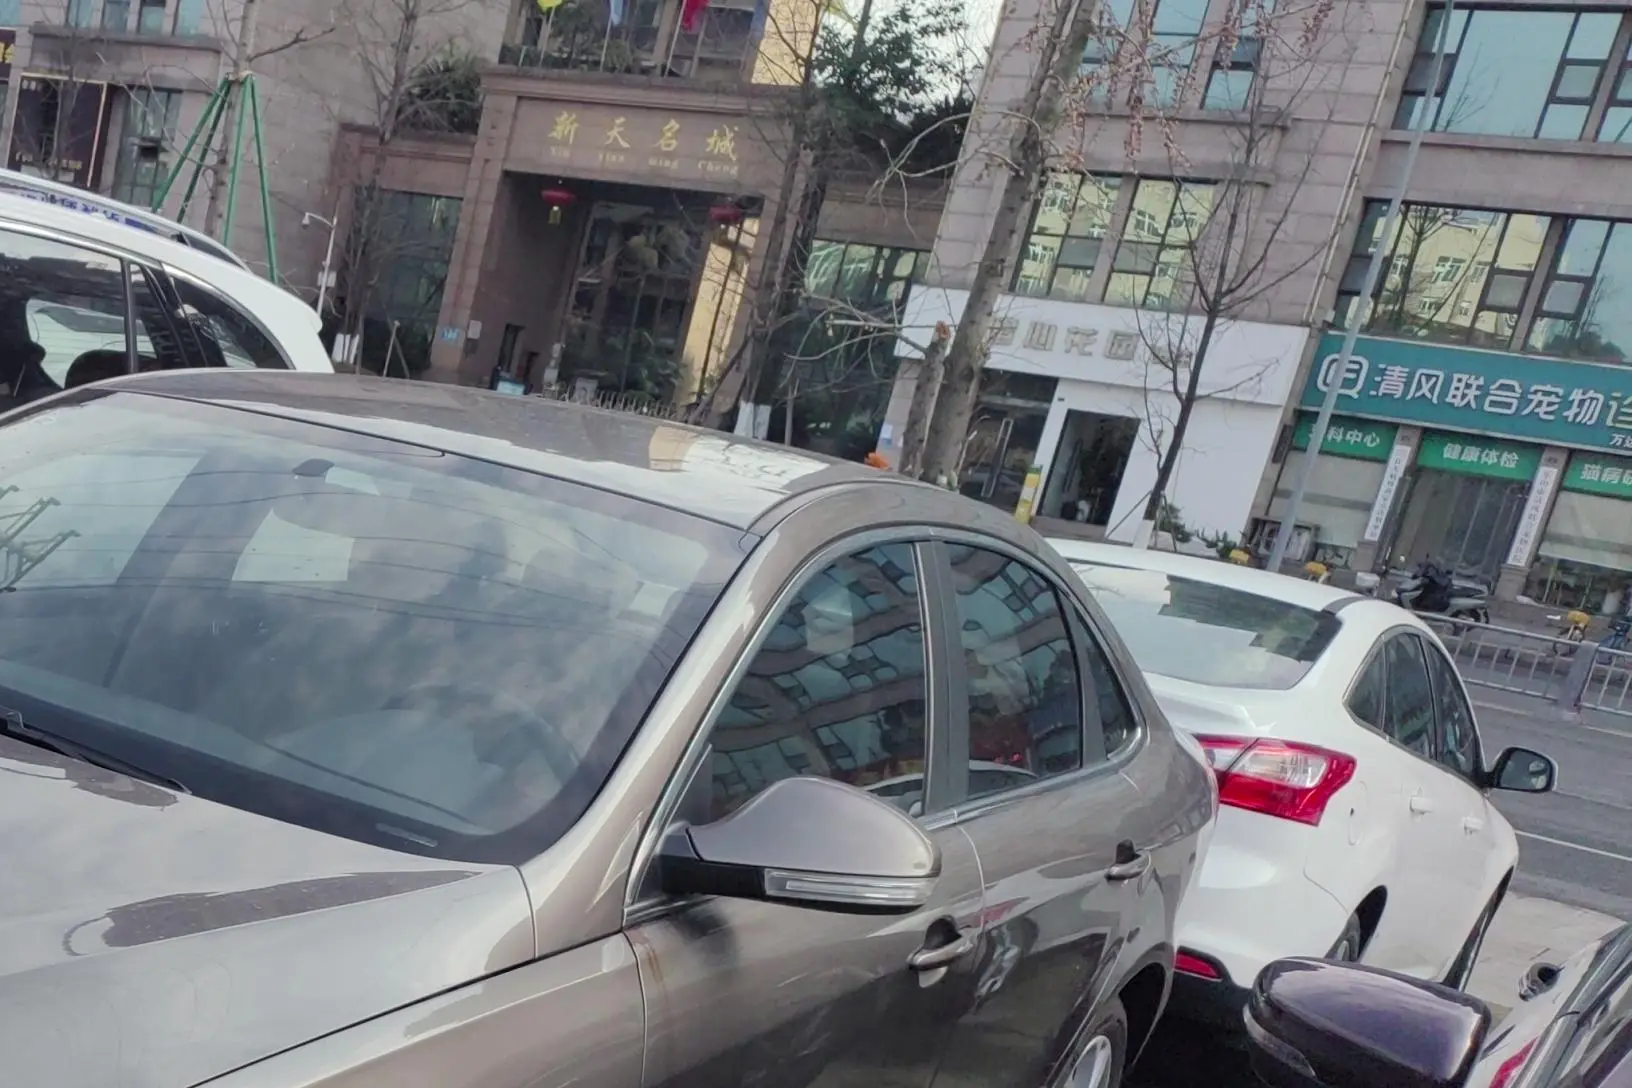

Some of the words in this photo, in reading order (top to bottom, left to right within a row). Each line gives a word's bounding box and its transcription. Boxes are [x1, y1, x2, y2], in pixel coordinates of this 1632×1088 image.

[548, 110, 739, 161] 新天名城
[1309, 423, 1380, 448] 科中心
[1442, 442, 1520, 469] 健康体检
